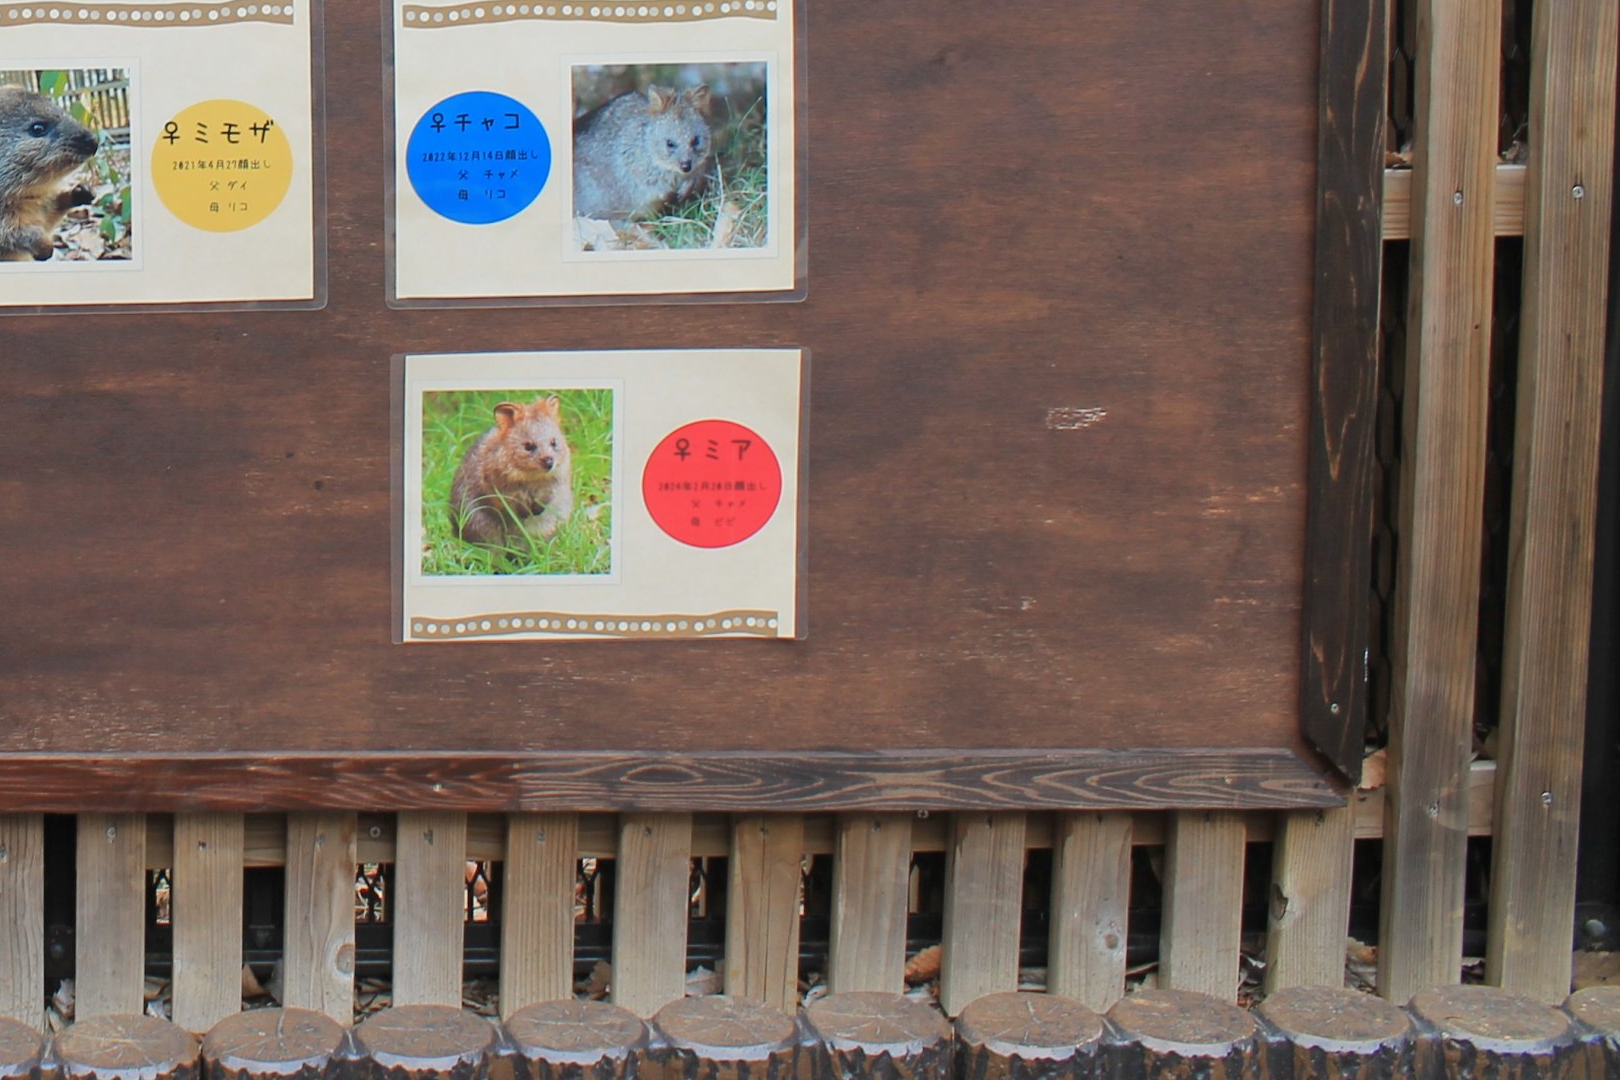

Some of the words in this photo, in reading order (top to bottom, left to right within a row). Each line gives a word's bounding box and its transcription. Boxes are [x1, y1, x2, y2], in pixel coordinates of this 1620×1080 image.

[195, 119, 274, 144] ミモザ
[454, 113, 519, 132] チャコ
[705, 439, 751, 461] ミア
